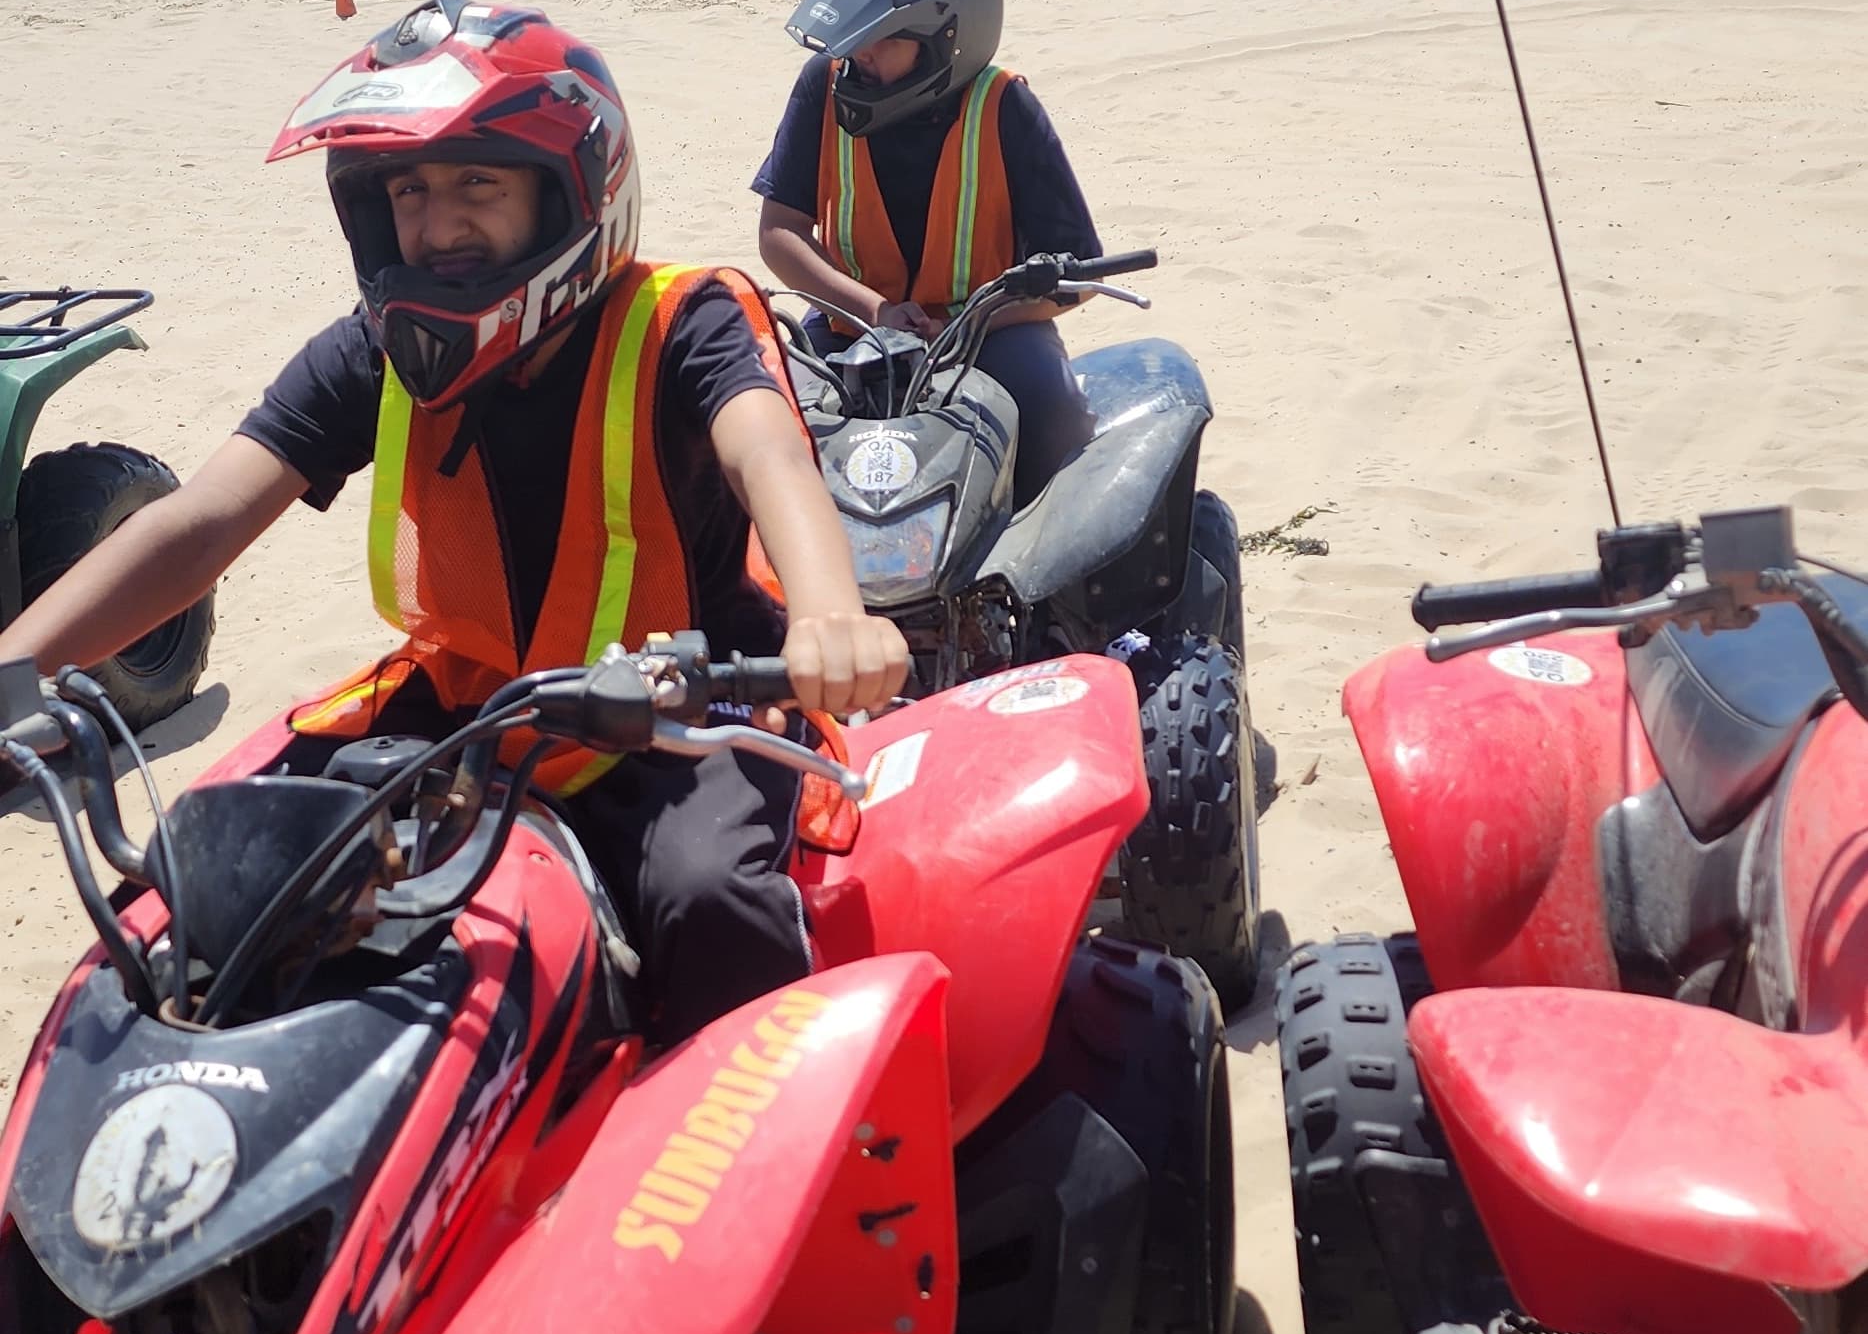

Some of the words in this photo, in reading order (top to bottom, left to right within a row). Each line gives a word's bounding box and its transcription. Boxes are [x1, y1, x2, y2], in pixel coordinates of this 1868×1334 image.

[865, 471, 894, 484] 187
[114, 1060, 270, 1094] HONDA
[612, 989, 832, 1263] SUNBUGGY
